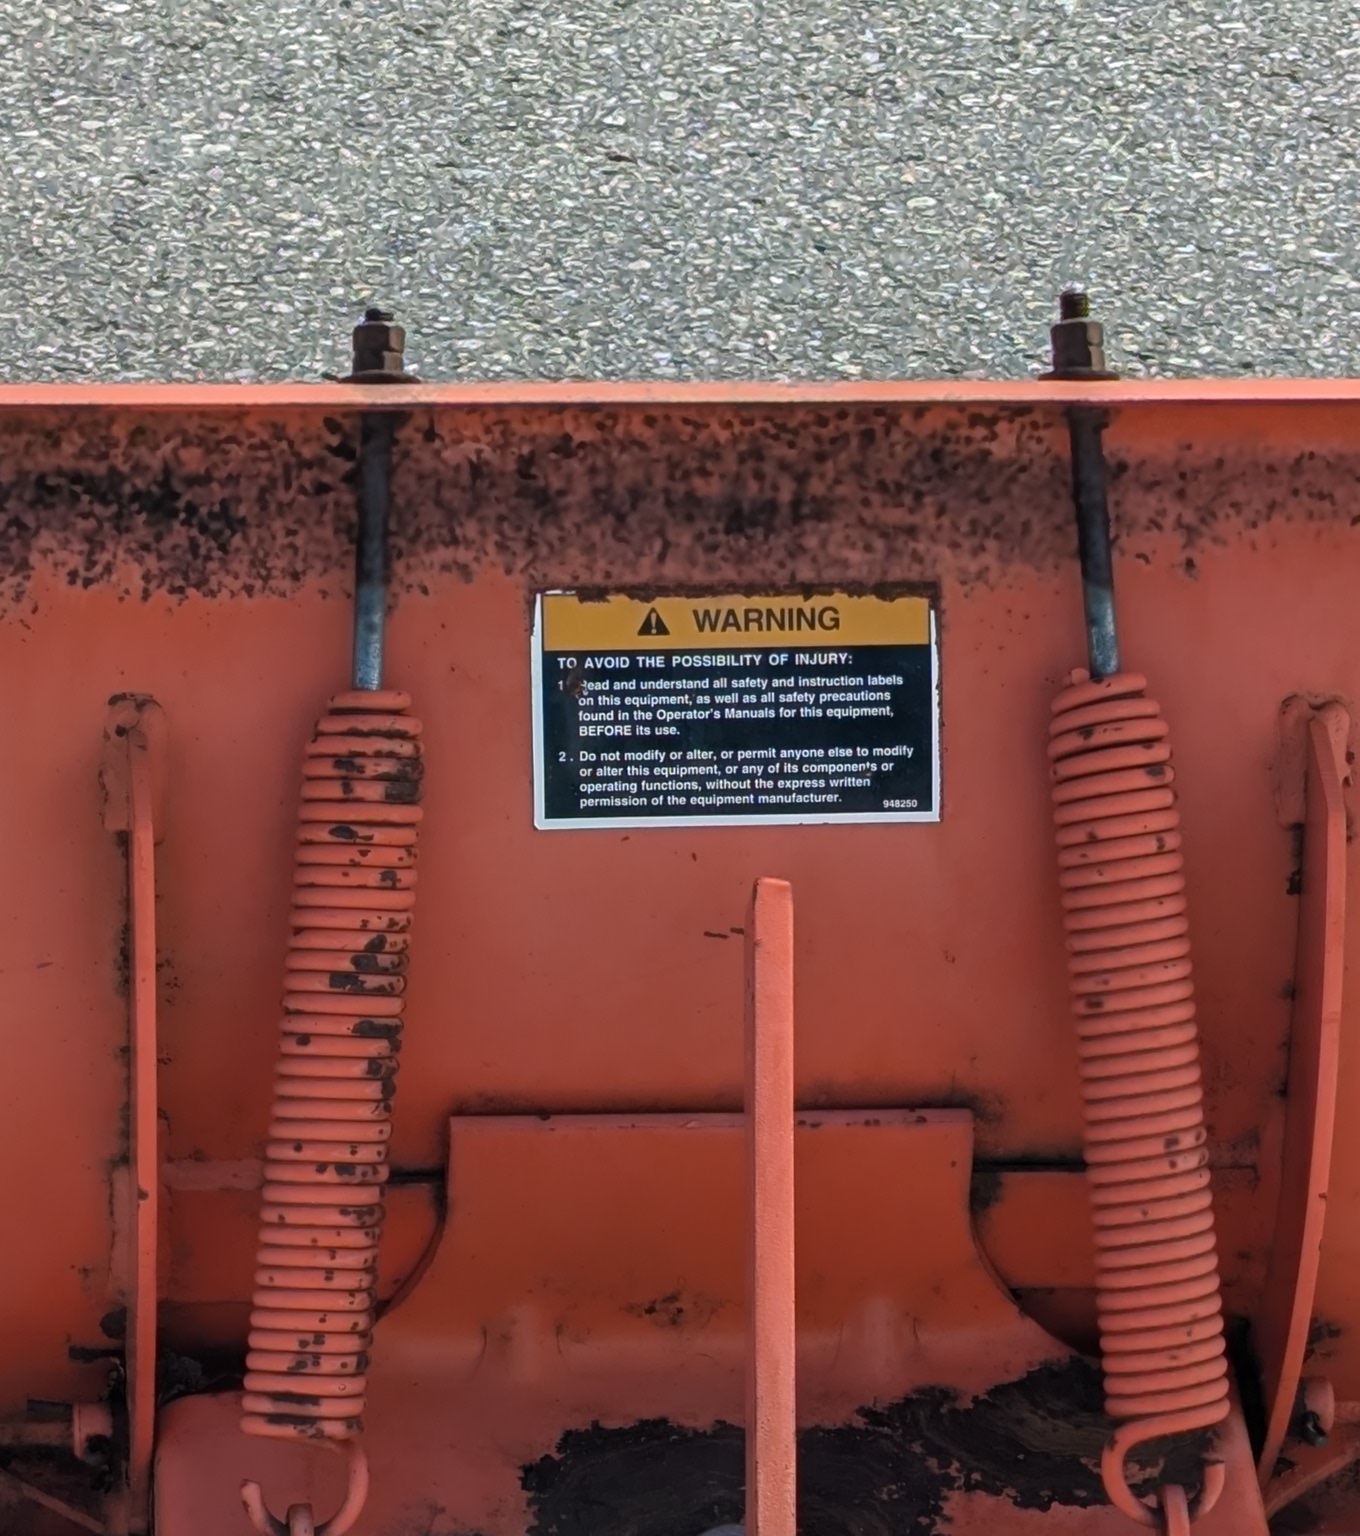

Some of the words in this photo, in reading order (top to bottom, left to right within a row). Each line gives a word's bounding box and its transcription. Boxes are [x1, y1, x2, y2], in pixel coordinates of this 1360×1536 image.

[693, 607, 840, 633] WARNING
[557, 657, 576, 669] TO
[585, 657, 629, 669] AVOID
[636, 656, 665, 668] THE
[672, 655, 762, 667] POSSIBILITY
[769, 654, 788, 666] OF
[795, 653, 853, 665] INJURY:
[614, 679, 635, 690] and
[640, 679, 709, 690] understand
[713, 678, 727, 689] all
[732, 677, 767, 690] safety
[772, 676, 794, 687] and
[798, 675, 863, 687] instruction
[868, 675, 903, 686] labels
[579, 697, 593, 706] on
[598, 694, 620, 705] this
[625, 694, 692, 707] equipment,
[696, 695, 710, 704] as
[714, 693, 739, 704] well
[742, 694, 757, 703] as
[761, 692, 775, 702] all
[779, 692, 815, 704] safety
[819, 690, 890, 704] precautions
[579, 710, 613, 721] found
[618, 710, 629, 720] in
[634, 710, 653, 720] the
[656, 709, 720, 722] Operator's
[724, 706, 776, 719] Manuals
[780, 707, 796, 717] for
[800, 706, 822, 717] this
[826, 706, 894, 719] equipment,
[579, 725, 632, 736] BEFORE
[636, 725, 651, 735] its
[655, 727, 680, 735] use.
[580, 751, 596, 761] Do
[601, 751, 620, 761] not
[625, 750, 666, 763] modify
[670, 751, 682, 760] or
[686, 749, 717, 761] alter,
[721, 750, 733, 759] or
[738, 748, 776, 760] permit
[780, 748, 824, 759] anyone
[828, 747, 853, 756] else
[857, 747, 869, 756] to
[873, 745, 913, 758] modify
[580, 768, 592, 777] or
[596, 766, 622, 776] alter
[627, 765, 650, 776] this
[654, 765, 721, 777] equipment,
[725, 765, 738, 775] or
[742, 764, 763, 776] any
[768, 762, 779, 773] of
[784, 762, 798, 773] its
[802, 761, 877, 776] components
[881, 762, 894, 771] or
[580, 781, 637, 793] operating
[641, 780, 701, 792] functions,
[705, 778, 752, 790] without
[755, 778, 773, 788] the
[778, 779, 825, 790] express
[829, 777, 871, 787] written
[580, 796, 647, 809] permission
[652, 795, 663, 805] of
[667, 795, 686, 805] the
[690, 793, 754, 807] equipment
[758, 793, 842, 804] manufacturer.
[883, 800, 917, 808] 948250
